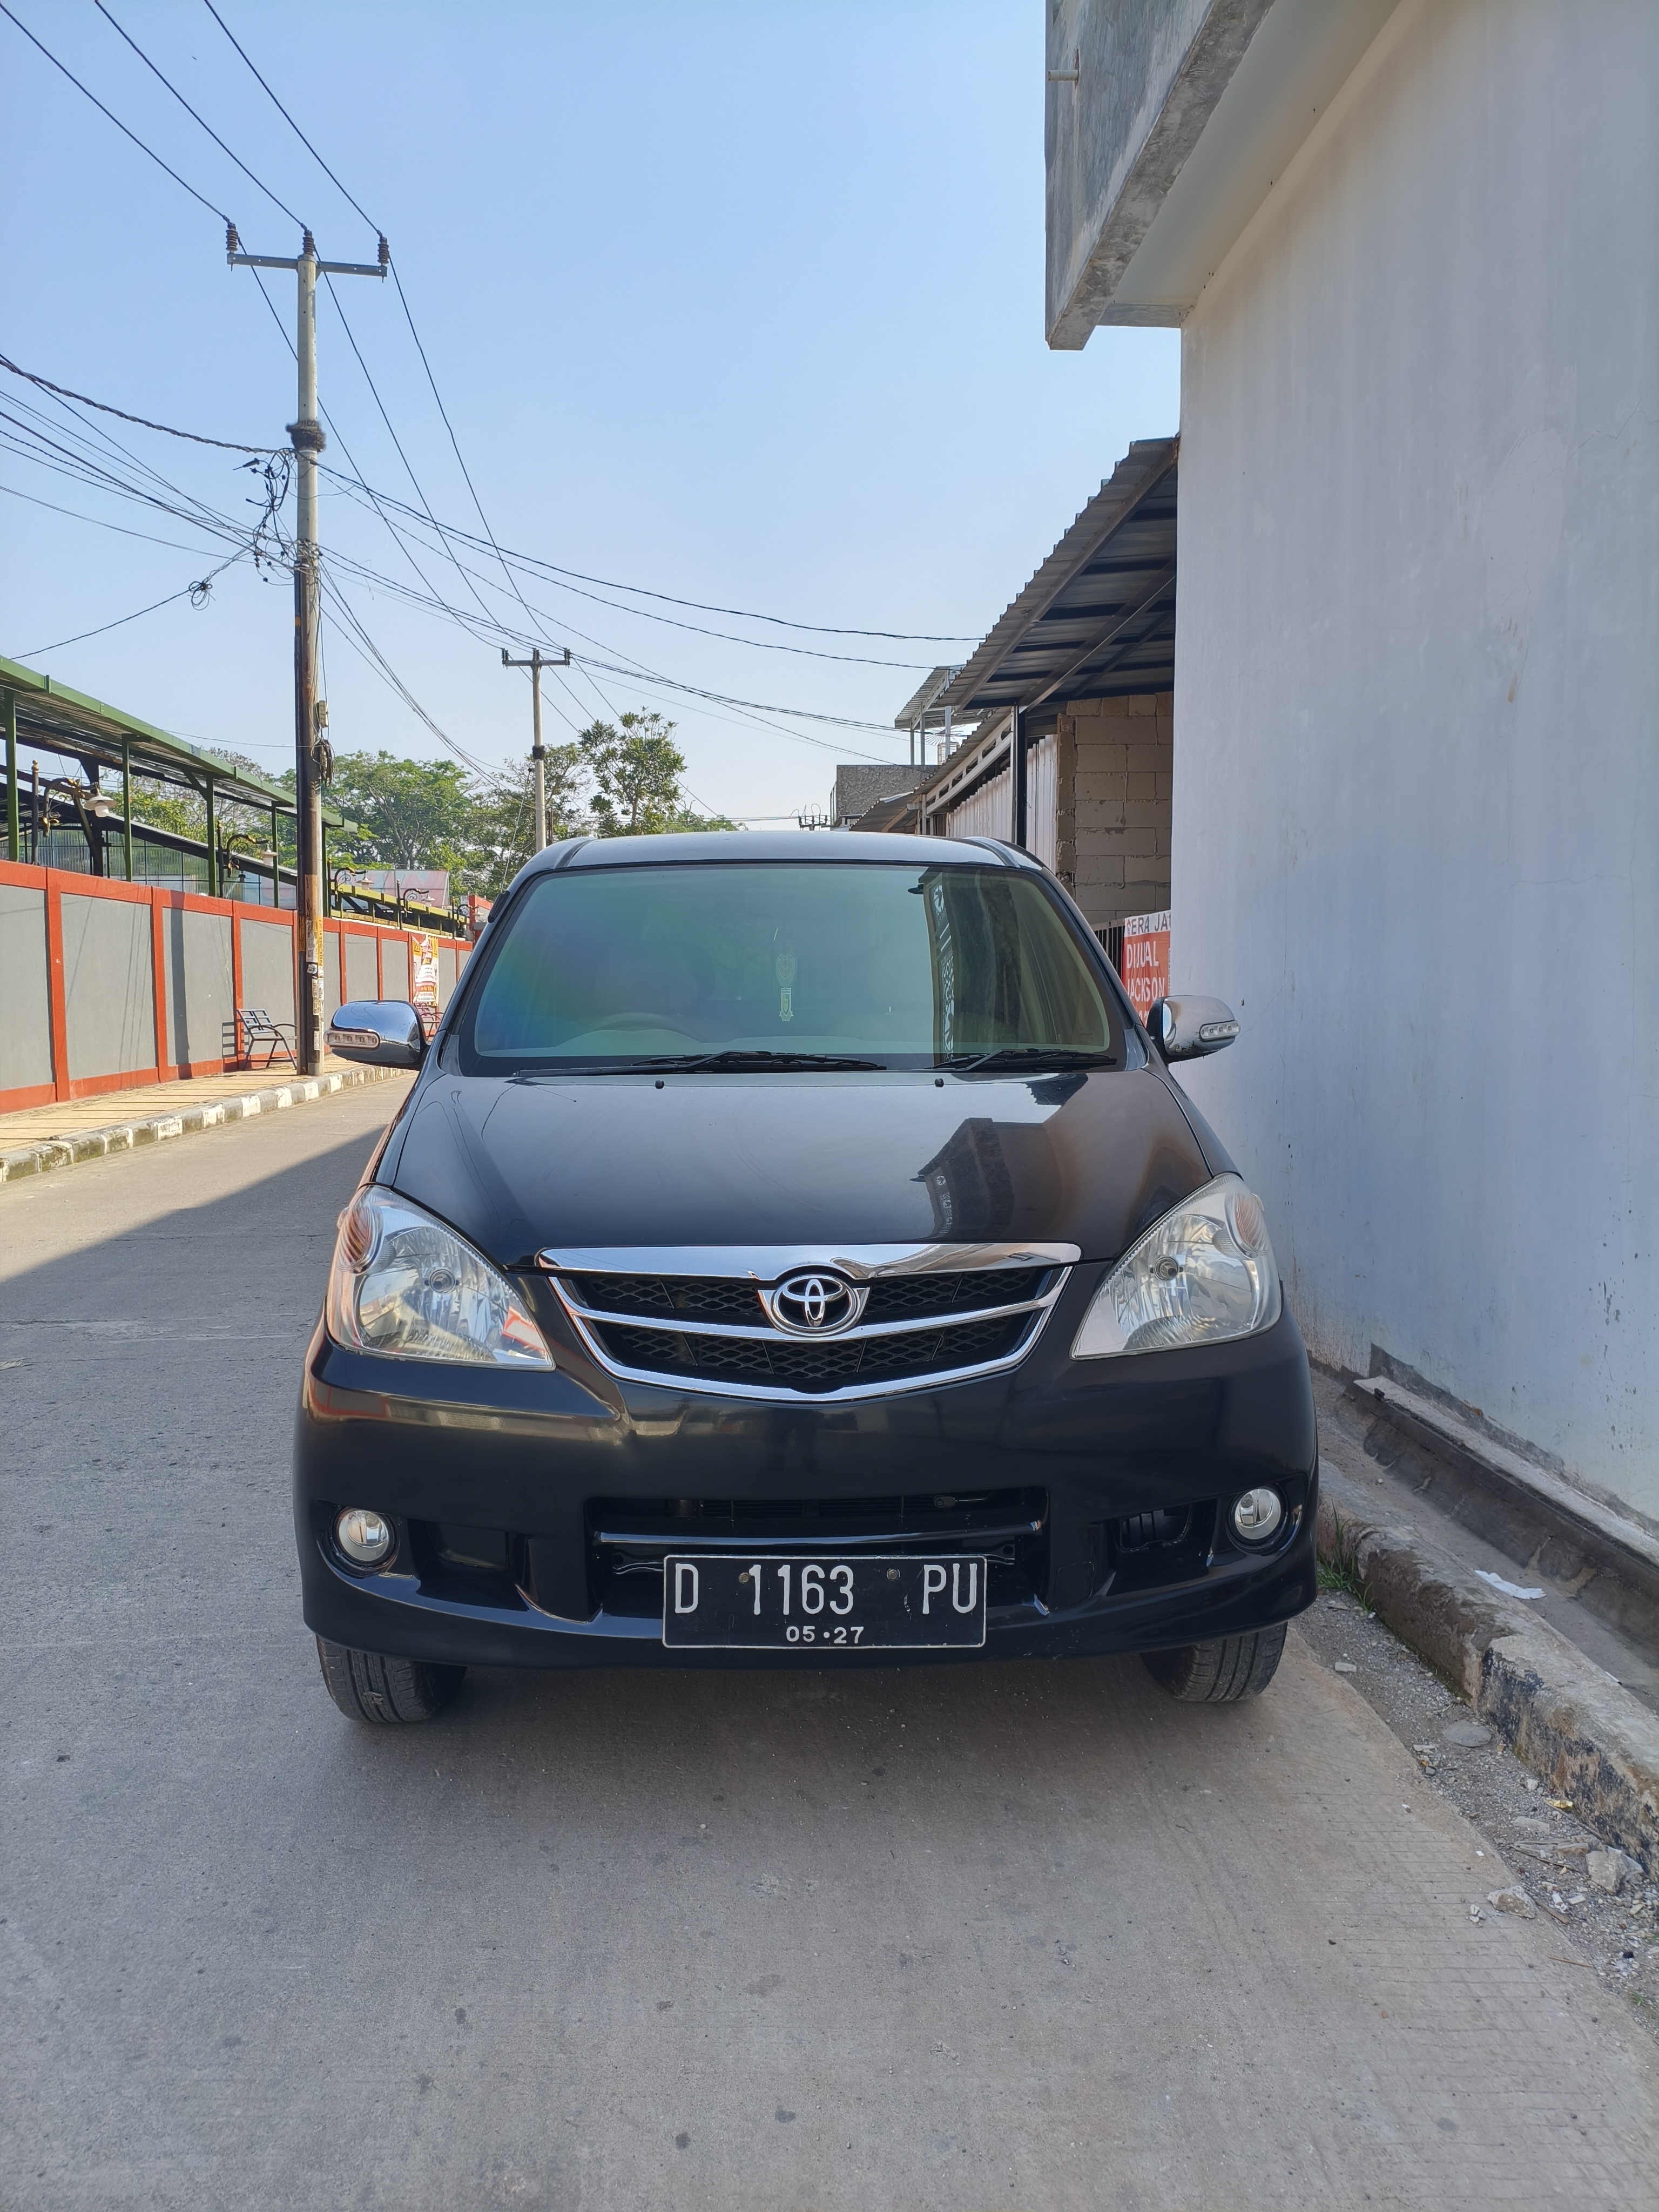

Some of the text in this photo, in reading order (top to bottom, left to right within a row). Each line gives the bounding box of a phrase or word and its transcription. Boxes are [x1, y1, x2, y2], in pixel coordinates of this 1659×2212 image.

[1131, 916, 1149, 935] ERA
[1155, 912, 1171, 932] JA
[1127, 941, 1159, 968] DIJUAL
[1127, 977, 1165, 1002] JACKSON
[675, 1563, 977, 1615] D 1163 PU
